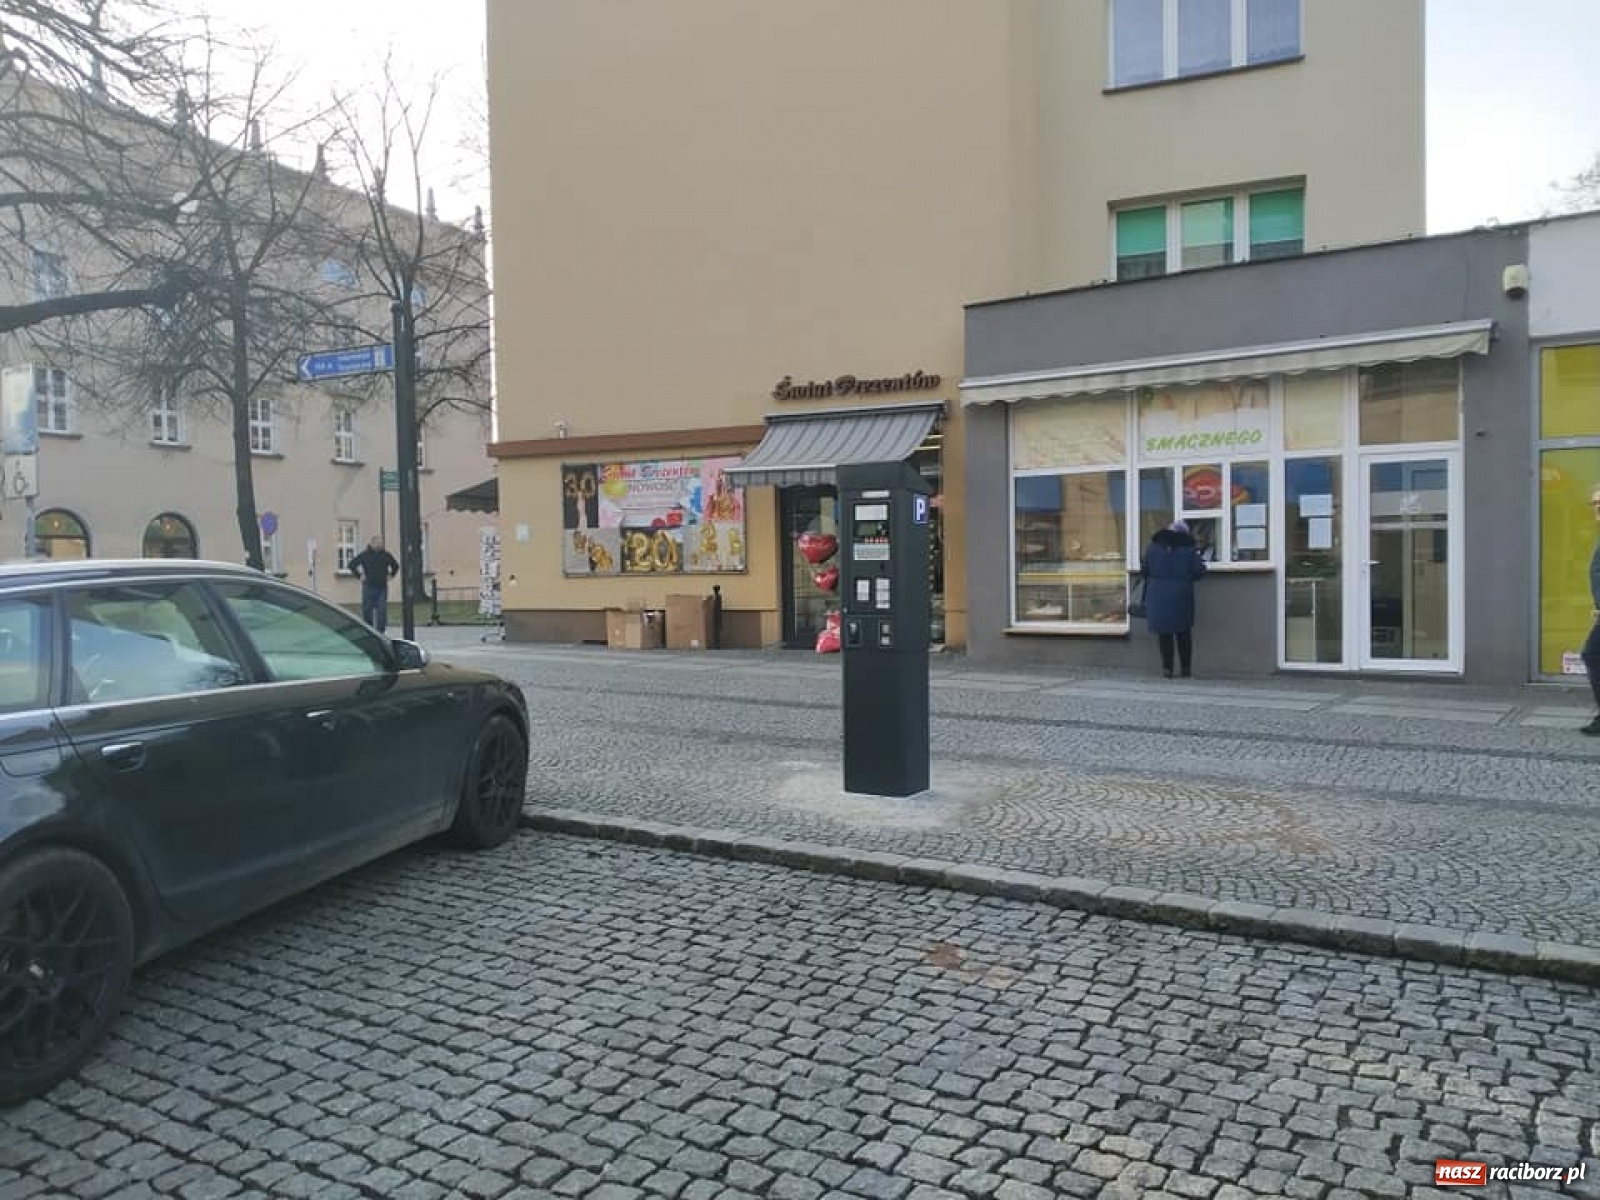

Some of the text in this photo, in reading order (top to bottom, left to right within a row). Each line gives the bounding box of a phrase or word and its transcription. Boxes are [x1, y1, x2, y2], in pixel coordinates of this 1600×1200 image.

[835, 370, 941, 395] Prezentów
[1146, 429, 1263, 452] SMACZNEGO
[916, 499, 926, 521] P
[625, 529, 679, 572] 20
